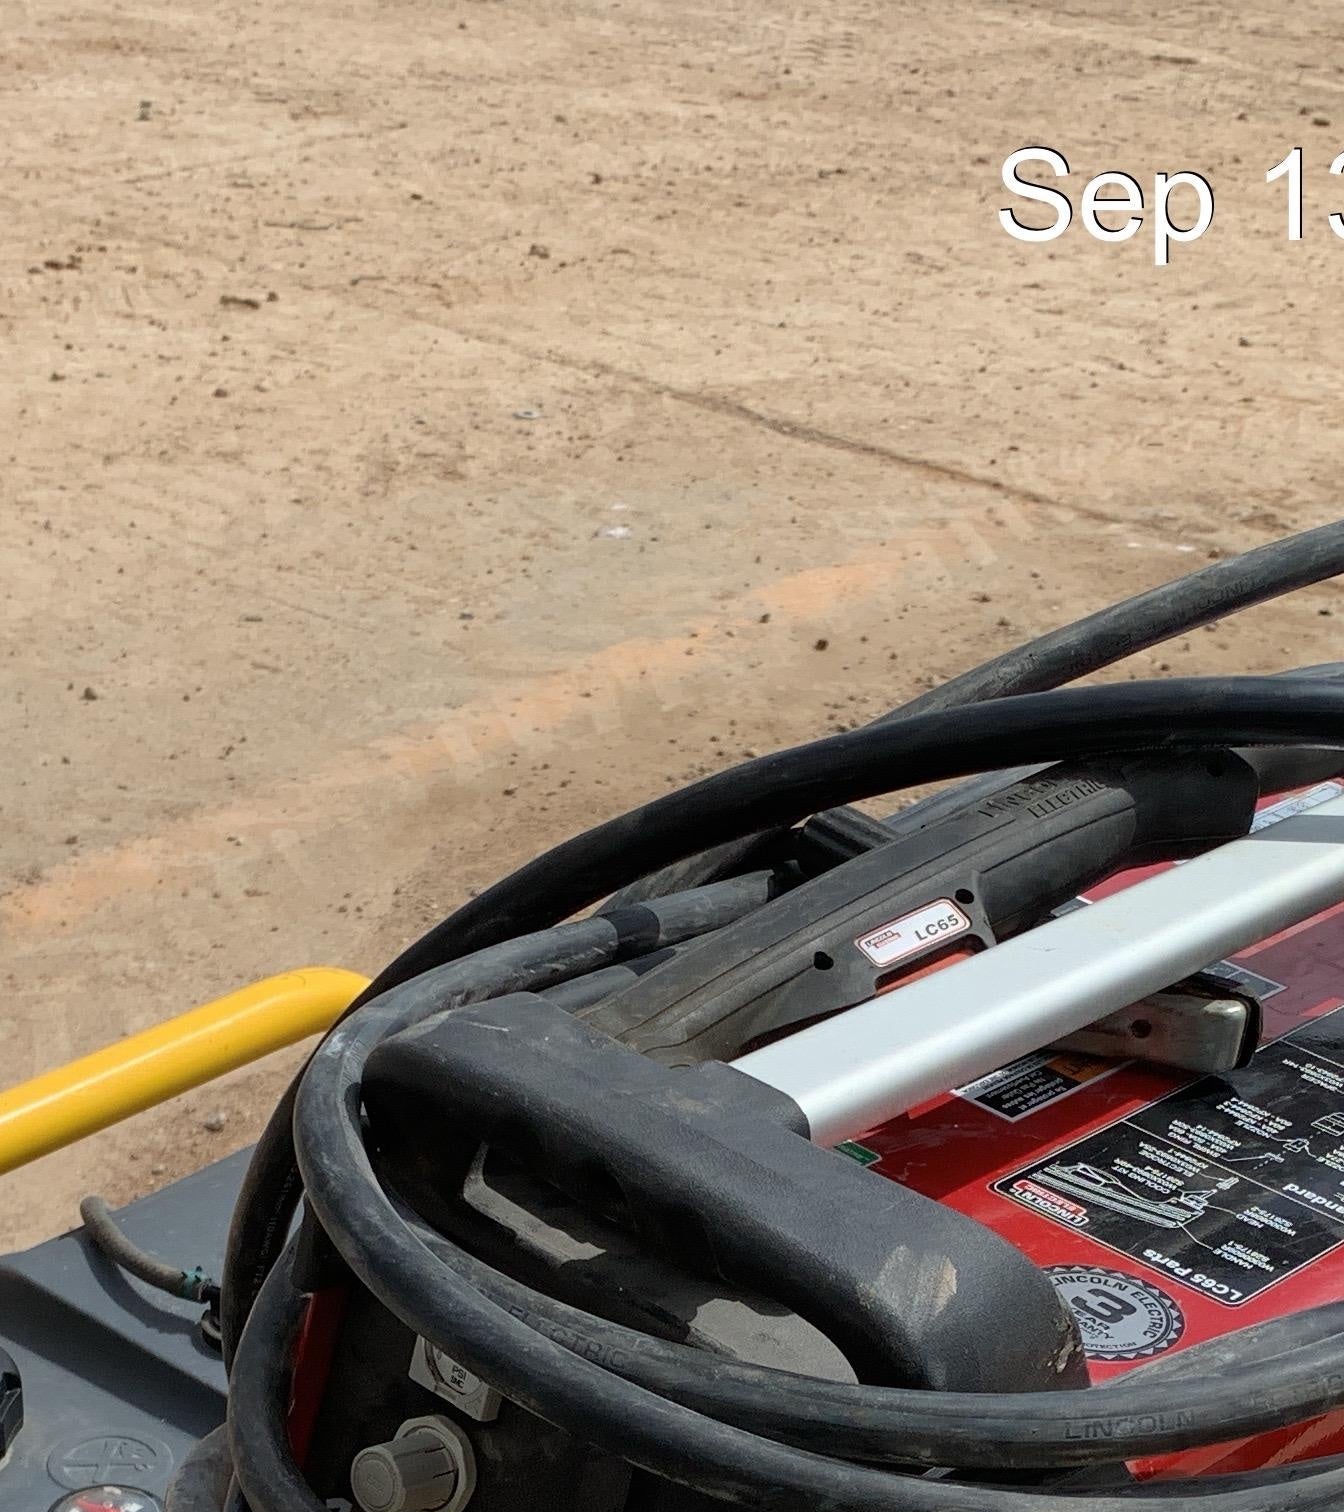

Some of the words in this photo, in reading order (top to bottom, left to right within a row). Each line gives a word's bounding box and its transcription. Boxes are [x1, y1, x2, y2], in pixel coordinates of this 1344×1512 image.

[915, 914, 959, 942] LC65
[1138, 1149, 1194, 1177] ELECTRODE
[1127, 1171, 1170, 1194] COOLING
[1015, 1190, 1085, 1223] LINCOLN
[1235, 1213, 1264, 1228] HEAD
[1142, 1248, 1192, 1276] Parts
[1212, 1247, 1253, 1269] HANDLE
[1190, 1273, 1242, 1300] LC65
[1071, 1288, 1137, 1324] 3
[1073, 1308, 1110, 1331] EAR
[1130, 1291, 1165, 1339] ELECTRIC
[452, 1364, 467, 1381] PSI
[1063, 1406, 1197, 1439] LINCOLN
